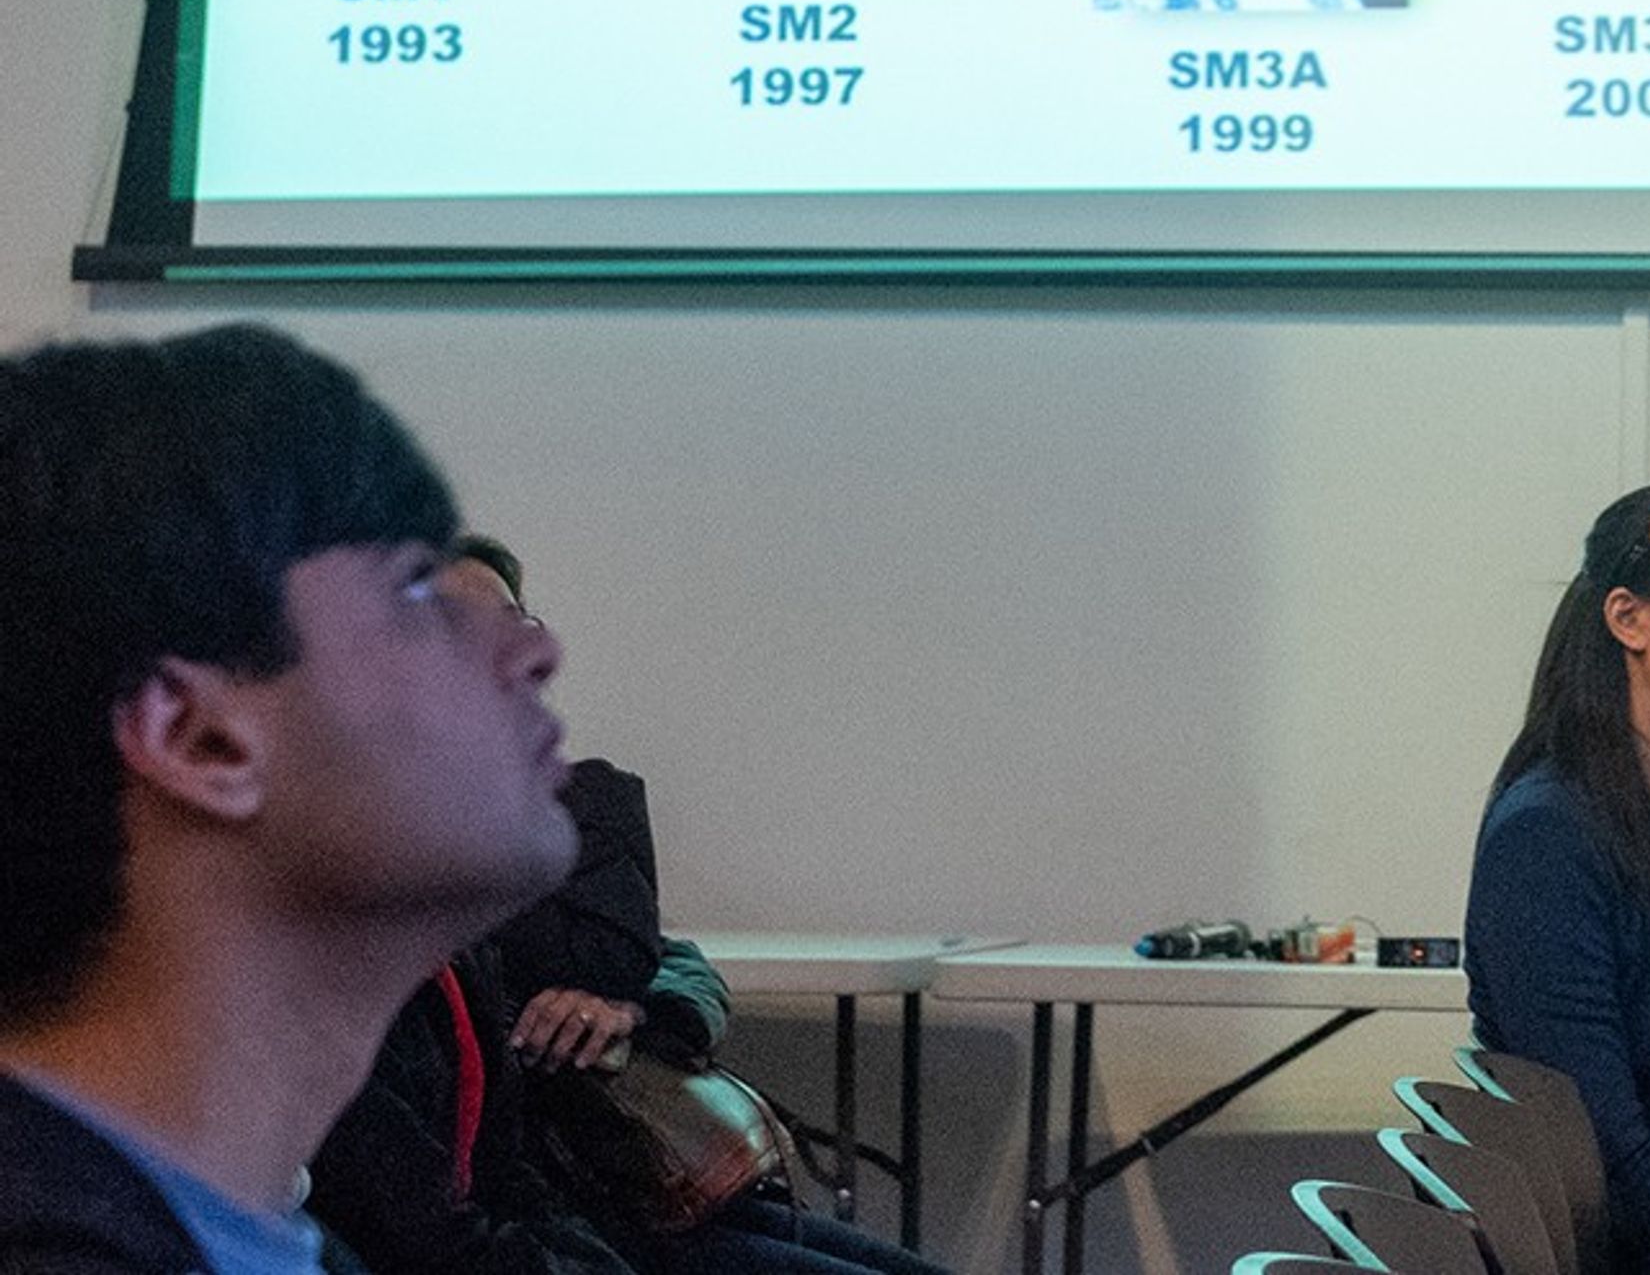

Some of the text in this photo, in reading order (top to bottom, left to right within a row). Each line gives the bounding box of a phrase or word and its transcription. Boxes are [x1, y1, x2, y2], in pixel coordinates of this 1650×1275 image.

[740, 3, 857, 42] SM2
[329, 23, 463, 64] 1993
[731, 66, 864, 106] 1997
[1169, 50, 1327, 90] SM3A
[1180, 113, 1313, 153] 1999
